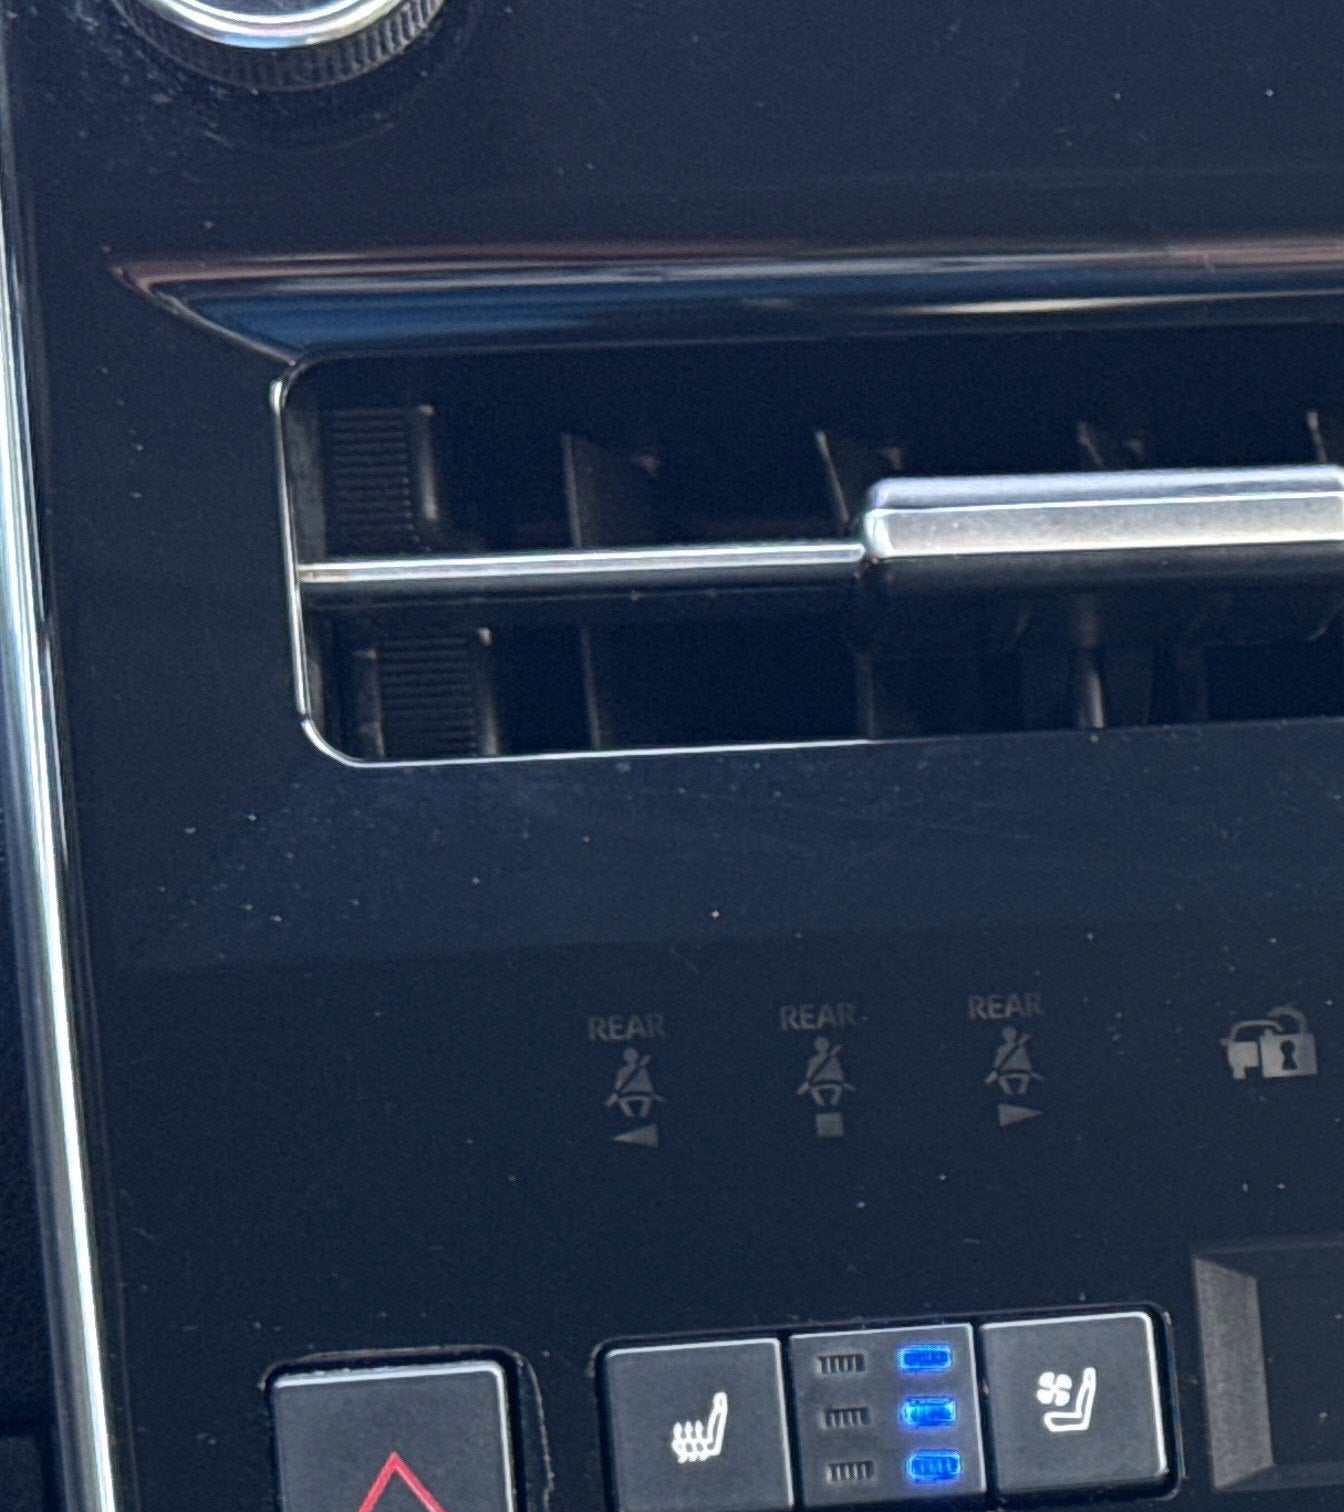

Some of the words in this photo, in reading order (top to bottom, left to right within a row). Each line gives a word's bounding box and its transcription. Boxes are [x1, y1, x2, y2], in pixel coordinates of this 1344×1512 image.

[780, 1002, 858, 1032] REAR
[968, 992, 1046, 1021] REAR
[588, 1012, 666, 1042] REAR
